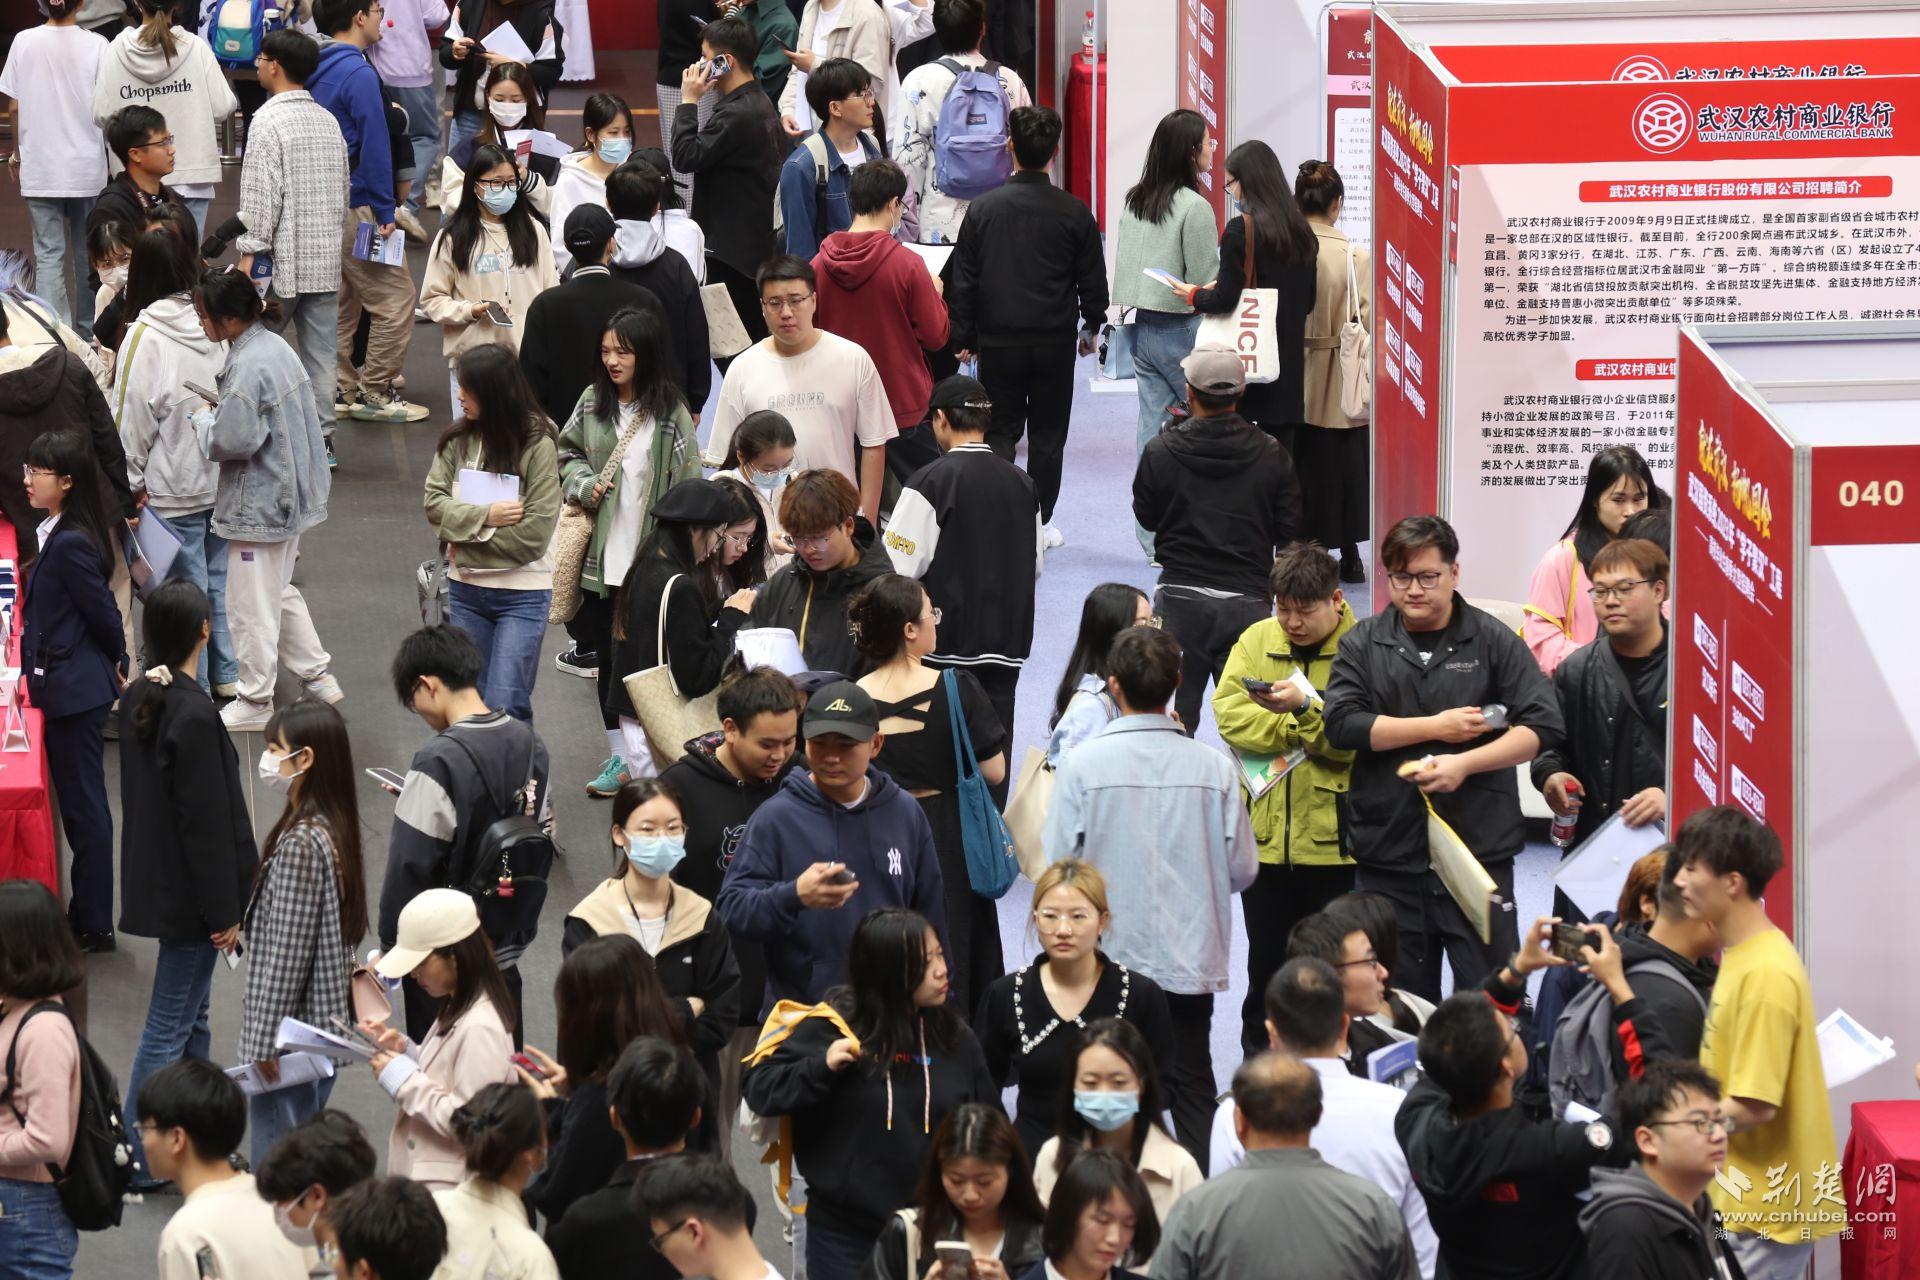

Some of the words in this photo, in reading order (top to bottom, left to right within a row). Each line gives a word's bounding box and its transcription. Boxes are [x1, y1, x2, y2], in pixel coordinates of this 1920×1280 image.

[119, 78, 192, 103] Chopsmith
[1697, 102, 1895, 131] 武汉农村商业银行
[1699, 131, 1742, 142] WUHAN
[1745, 130, 1782, 141] RURAL
[1784, 129, 1858, 140] COMMERCIAL
[1861, 128, 1893, 139] BANK
[1608, 180, 1862, 198] 武汉农村商业银行股份有限公司招聘简介
[1485, 227, 1920, 245] 是一家总部在汉的区域性银行。截至目前，全行200余网点遍布武汉城乡。在武汉市外，
[1484, 260, 1920, 277] 银行。全行综合经营指标位居武汉市金融同业“第一方阵”。综合纳税额连续多年在全市
[1484, 276, 1920, 293] 第一，荣获“湖北省信贷投放贡献突出机构、全省脱贫攻坚先进集体、金融支持地方经济
[1505, 309, 1920, 326] 为进一步加快发展，武汉农村商业银行面向社会招聘部分岗位工作人员，诚邀社会各
[1483, 330, 1576, 342] 高校优秀学子加盟。
[1839, 479, 1904, 507] 040
